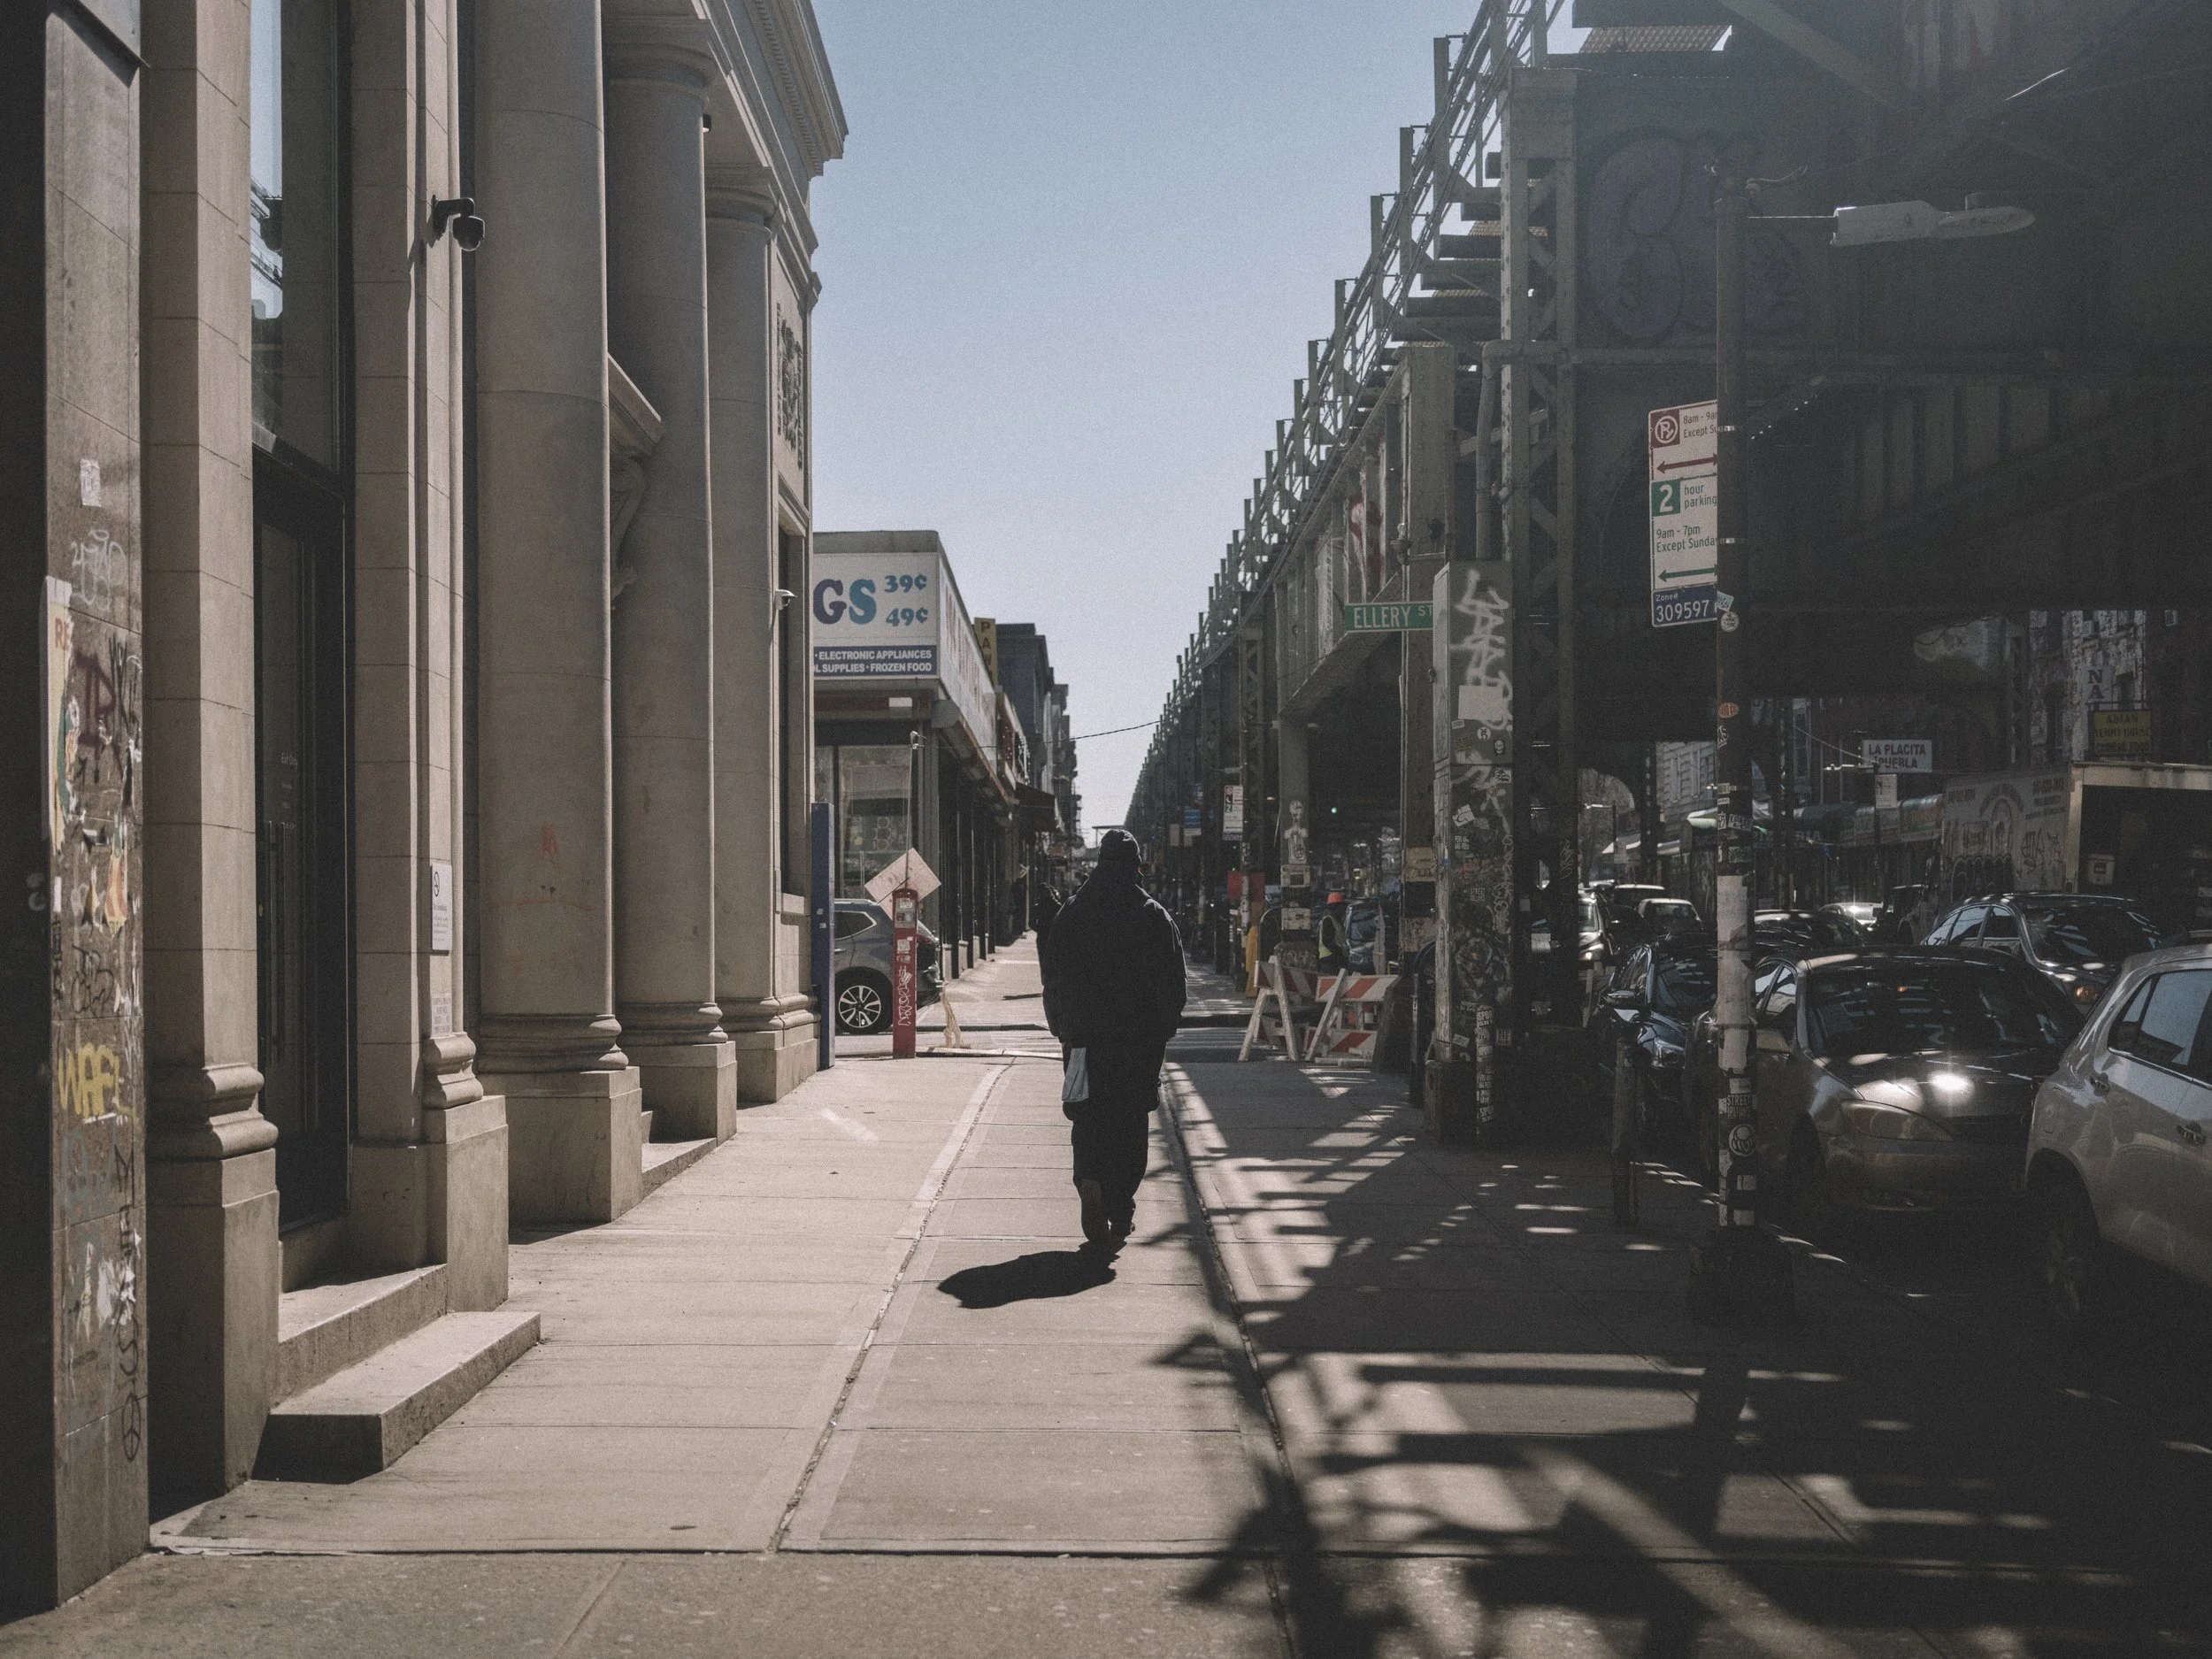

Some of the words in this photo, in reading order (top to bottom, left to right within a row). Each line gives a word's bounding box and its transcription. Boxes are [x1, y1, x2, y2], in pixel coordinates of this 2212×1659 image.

[1684, 415, 1699, 425] 8am
[1684, 426, 1708, 439] Except
[1685, 485, 1704, 495] hour
[1658, 484, 1673, 513] 2
[1685, 495, 1717, 511] parking
[1656, 528, 1675, 539] 9am
[1684, 526, 1701, 537] 7pm
[1656, 539, 1686, 552] Except
[885, 574, 927, 593] 39¢
[813, 579, 877, 625] GS
[886, 607, 928, 626] 49¢
[1354, 605, 1411, 628] ELLERY
[1656, 599, 1709, 623] 309597
[819, 651, 875, 661] ELECTRONIC
[876, 649, 933, 659] APPLIANCES
[822, 663, 865, 672] SUPPLIES
[871, 663, 906, 672] FROZEN
[907, 662, 933, 672] FOOD
[1869, 744, 1881, 755] LA
[1884, 744, 1926, 755] PLACITA
